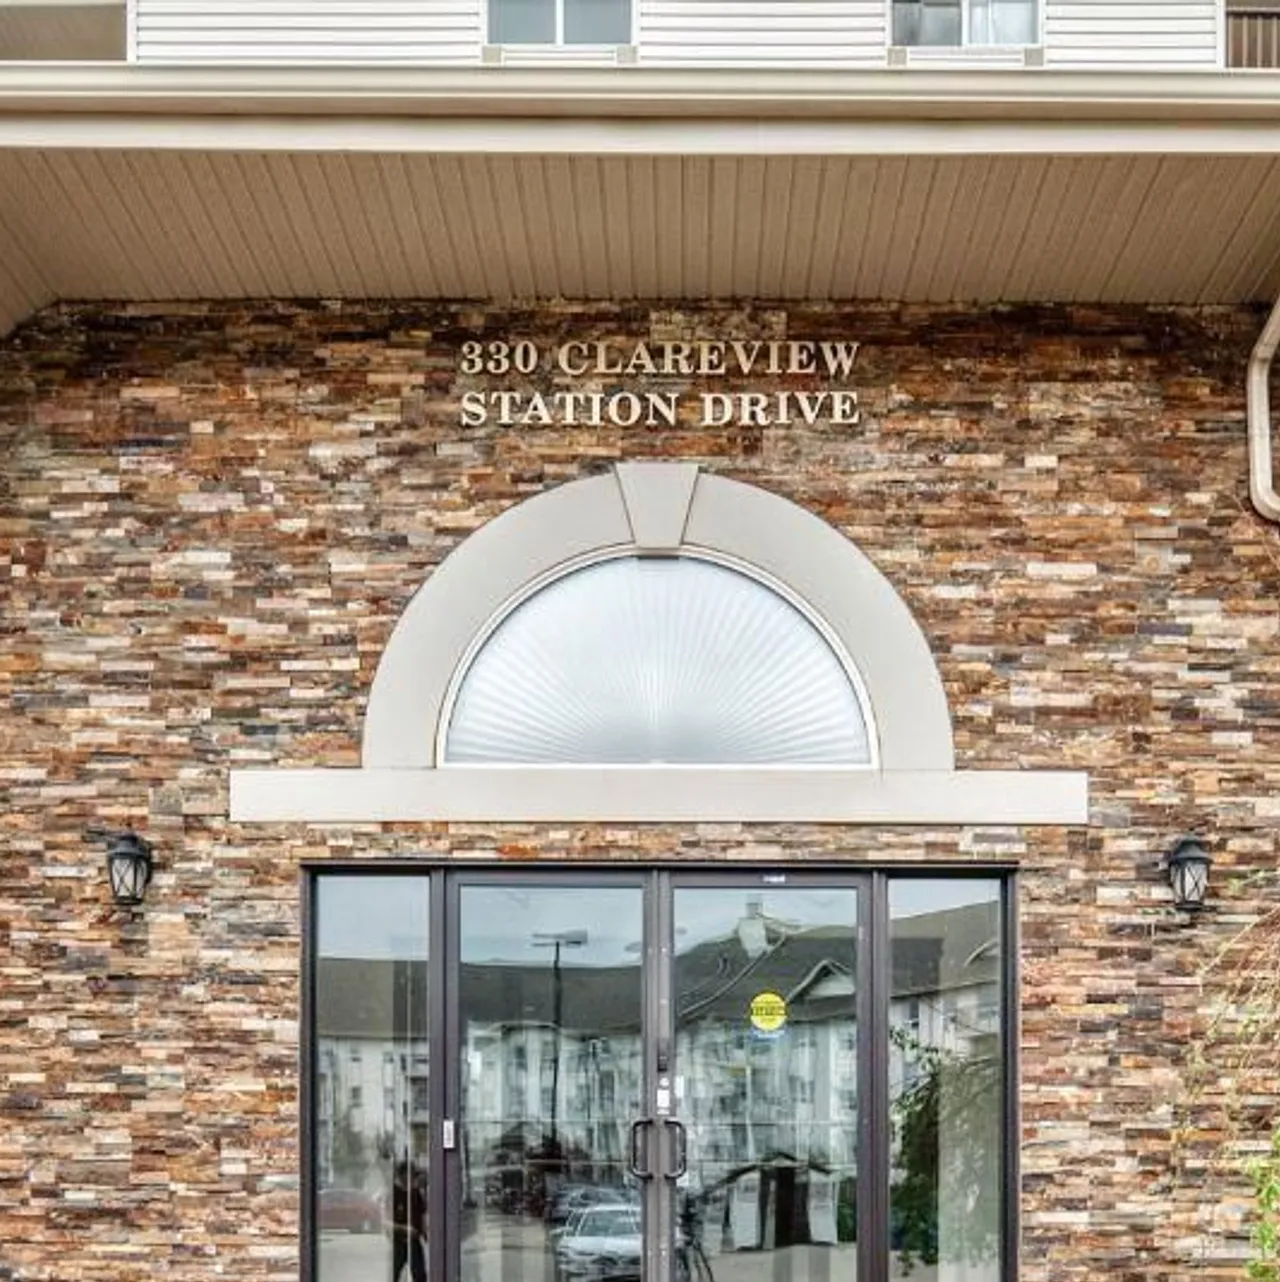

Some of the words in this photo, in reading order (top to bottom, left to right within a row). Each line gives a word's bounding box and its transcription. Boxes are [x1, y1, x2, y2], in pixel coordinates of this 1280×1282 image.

[460, 341, 539, 375] 330
[558, 341, 861, 377] CLAREVIEW
[460, 391, 681, 427] STATION
[700, 391, 861, 426] DRIVE
